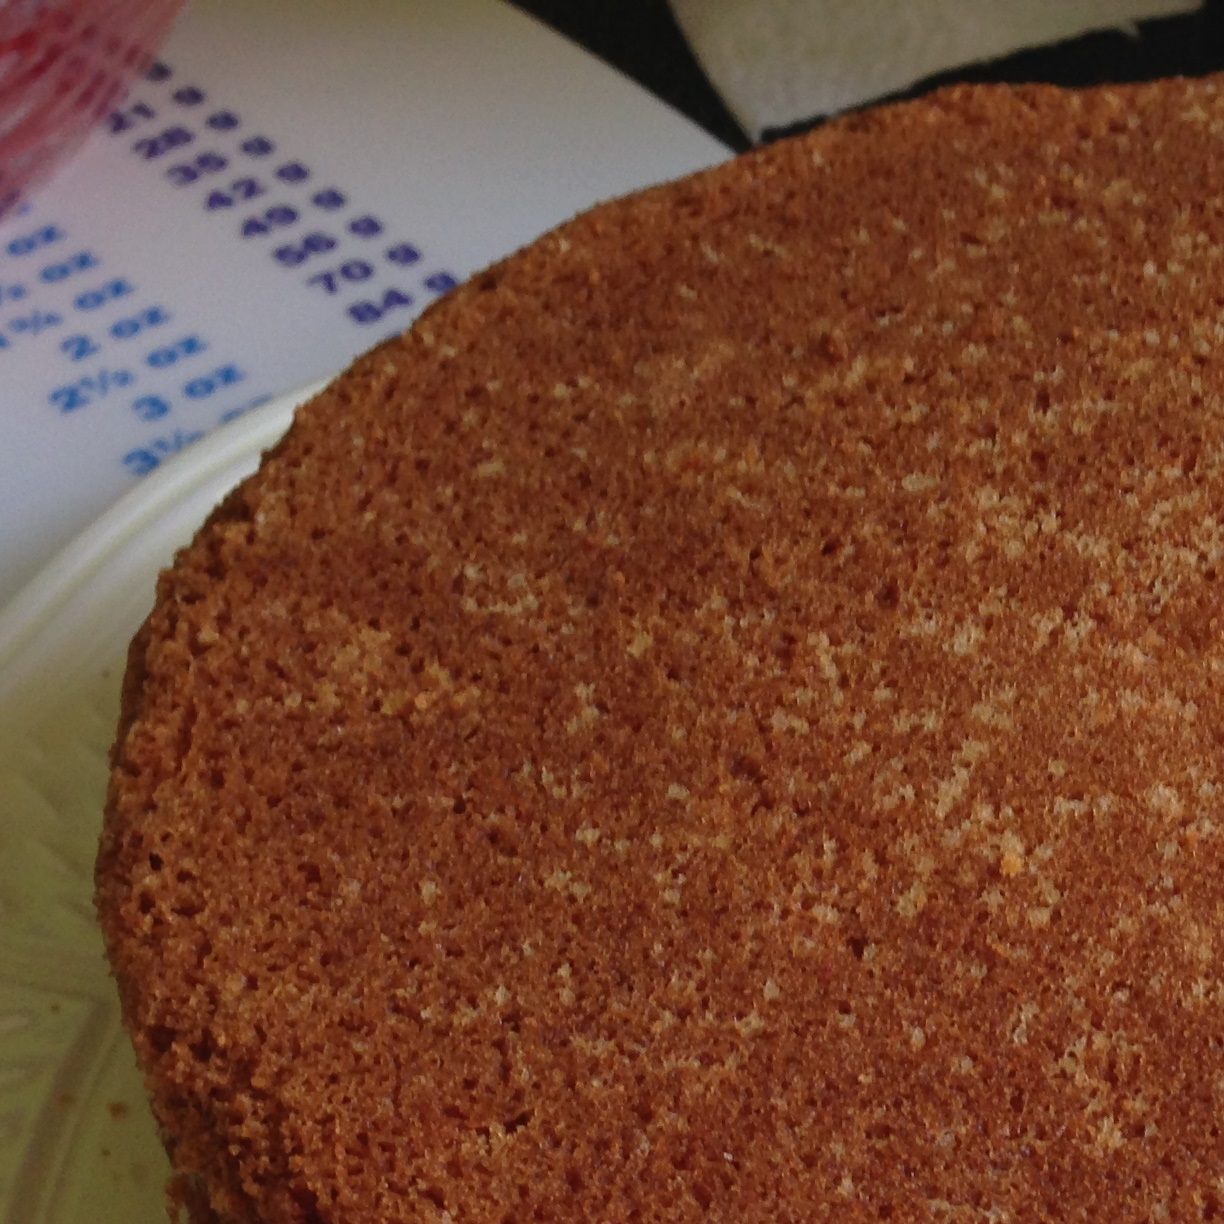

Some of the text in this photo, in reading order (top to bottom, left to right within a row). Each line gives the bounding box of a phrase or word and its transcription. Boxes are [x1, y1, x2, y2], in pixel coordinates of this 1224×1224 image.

[306, 260, 374, 296] 70
[346, 289, 410, 325] 84
[60, 305, 171, 362] 2 oz
[146, 334, 208, 369] oz
[132, 363, 246, 421] 3 oz
